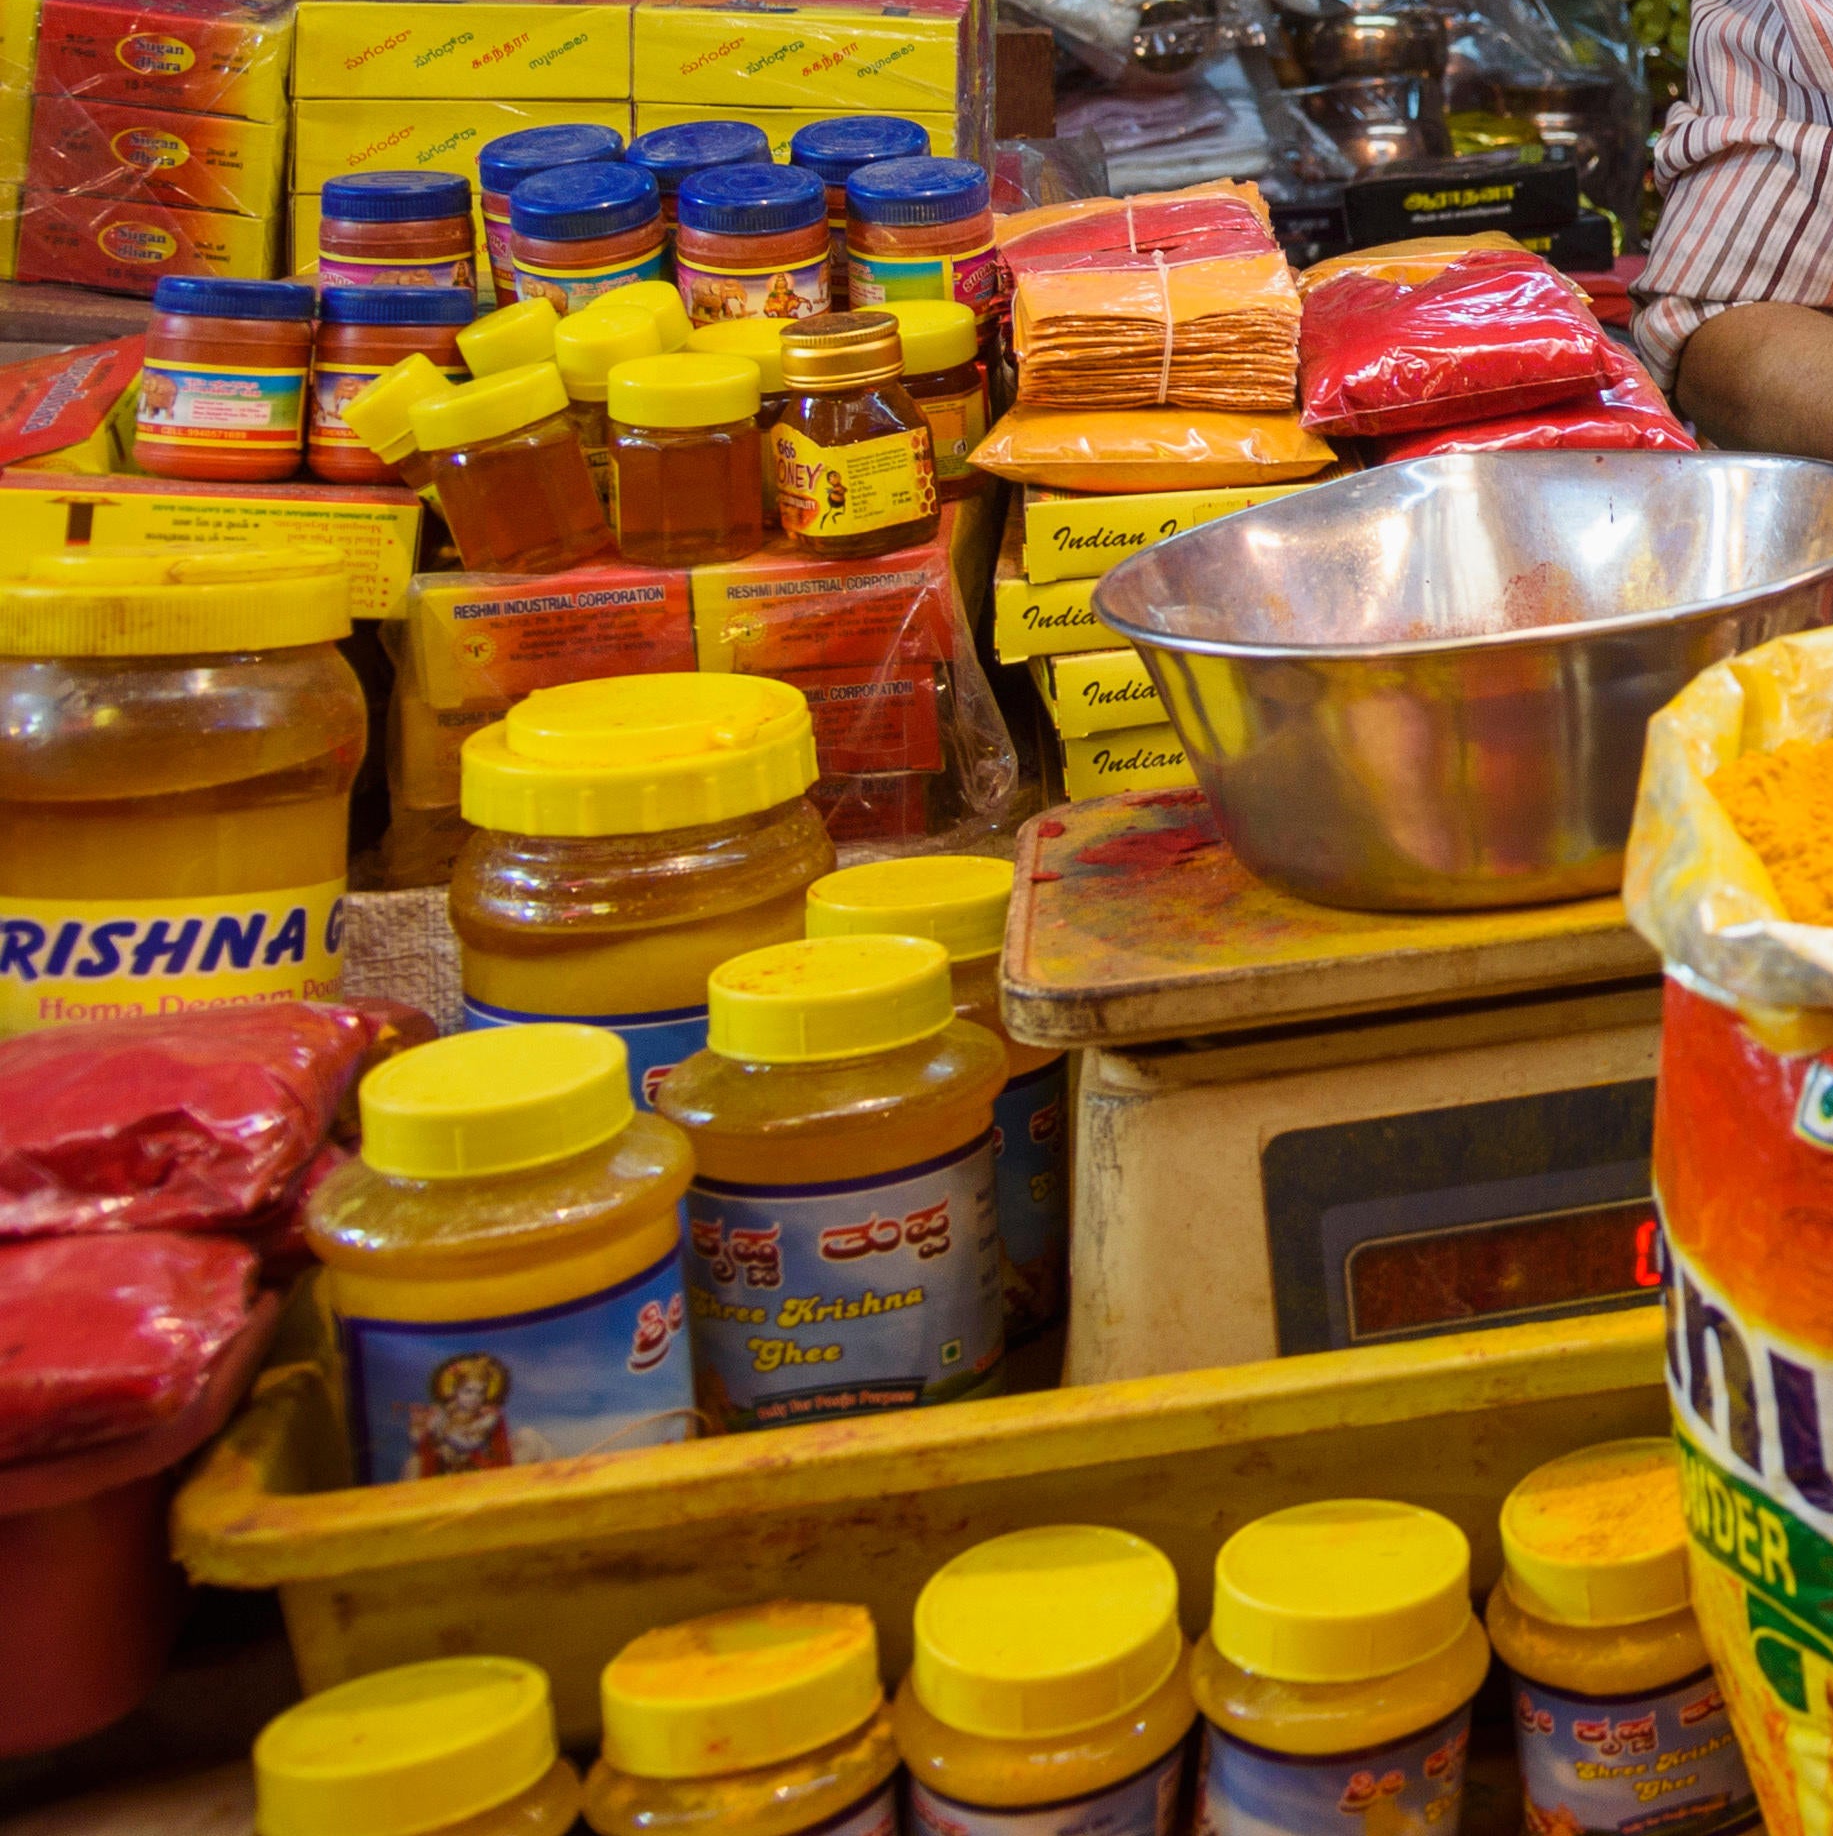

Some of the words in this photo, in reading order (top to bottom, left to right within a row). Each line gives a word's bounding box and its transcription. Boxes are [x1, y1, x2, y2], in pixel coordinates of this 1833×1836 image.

[135, 37, 185, 57] Sugan
[134, 56, 182, 73] dhara
[129, 132, 179, 152] Sugan
[119, 227, 167, 246] Sugan
[1053, 526, 1147, 552] Indian
[727, 583, 772, 601] RESHMI
[775, 578, 843, 598] INDUSTRIAL
[846, 570, 929, 591] CORPORATION
[453, 601, 502, 621] RESHMI
[504, 595, 576, 616] INDUSTRIAL
[577, 585, 666, 610] CORPORATION
[1022, 605, 1098, 631] India
[1082, 681, 1157, 707] India
[1093, 748, 1187, 775] Indian
[39, 996, 144, 1021] Homa
[775, 1283, 924, 1330] Krishna
[747, 1335, 843, 1373] Ghee
[1574, 1760, 1649, 1782] Shree
[1654, 1731, 1737, 1776] Krishn
[1632, 1773, 1698, 1804] Ghee
